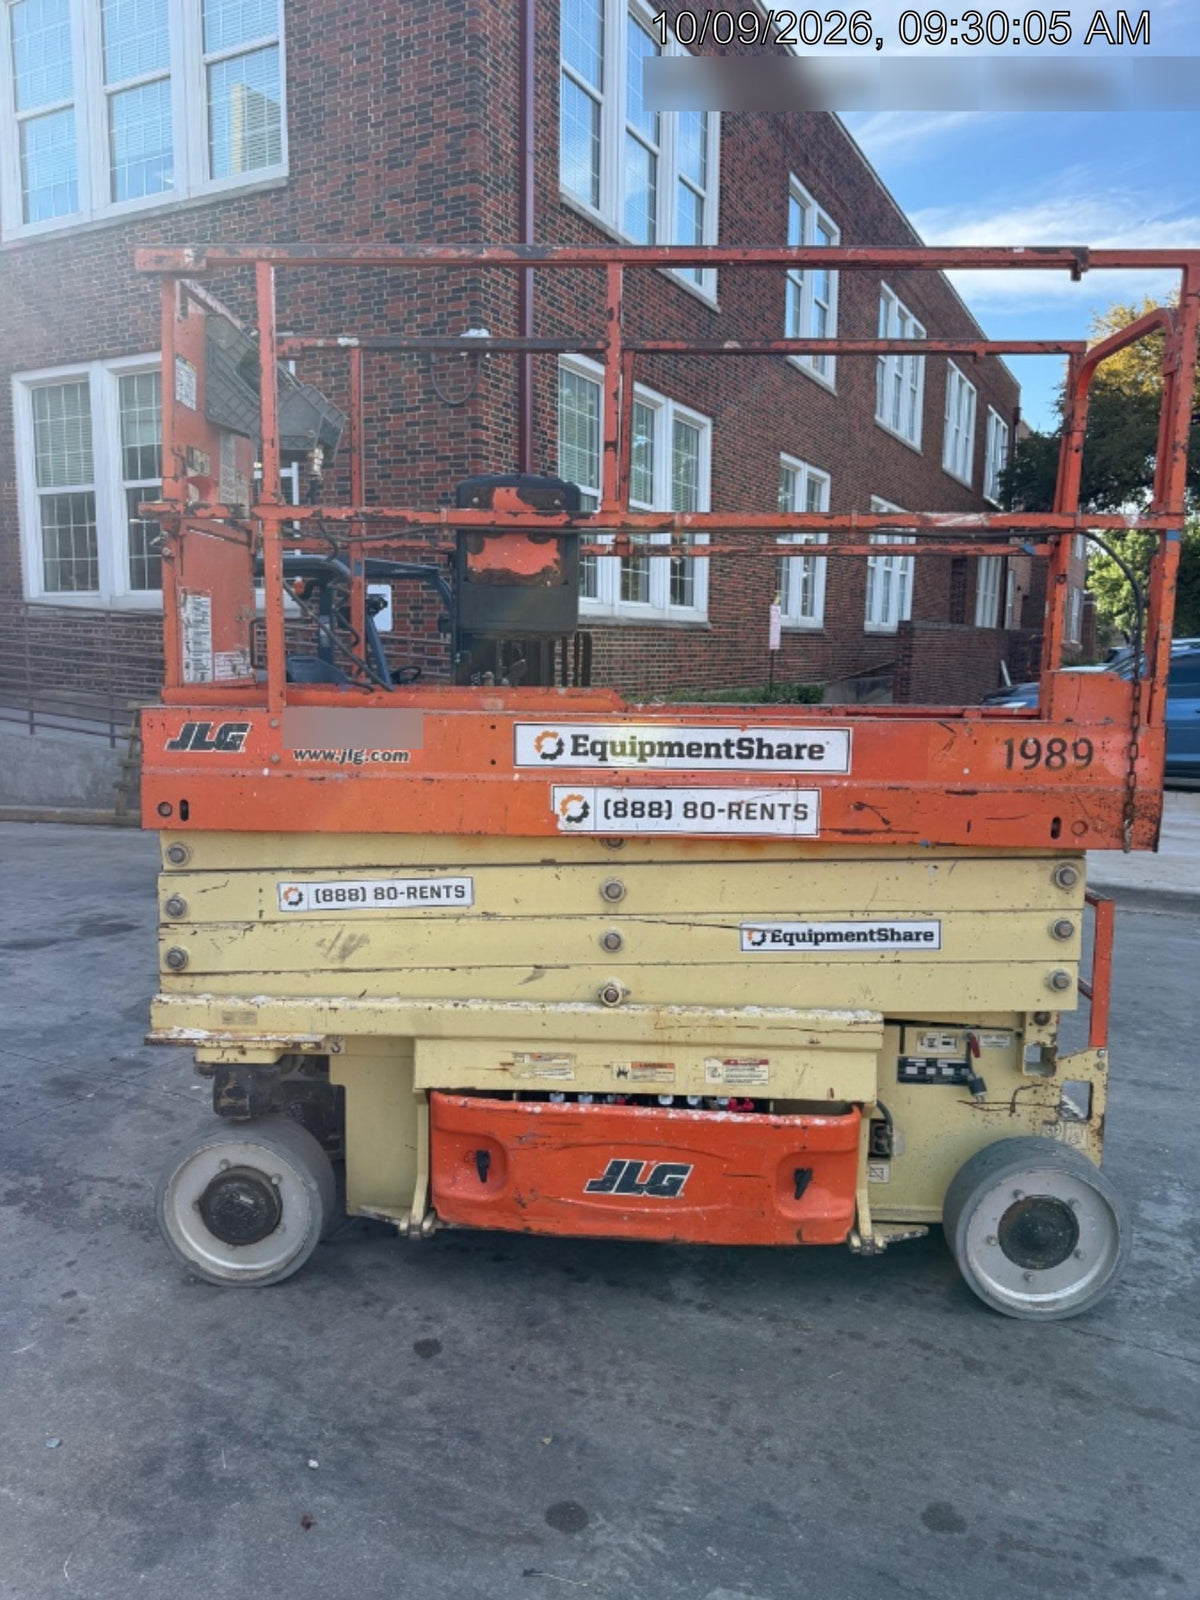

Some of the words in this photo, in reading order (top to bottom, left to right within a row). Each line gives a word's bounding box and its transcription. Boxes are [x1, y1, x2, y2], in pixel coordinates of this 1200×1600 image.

[164, 721, 251, 752] JLG
[570, 733, 826, 762] EquipmentShare
[293, 749, 409, 765] www.jlg.com
[1004, 737, 1094, 771] 1989
[603, 799, 673, 821] (888)
[682, 800, 809, 821] 80-RENTS
[314, 886, 367, 904] (888)
[373, 884, 466, 901] 80-RENTS
[770, 927, 935, 946] EquipmentShare
[582, 1158, 694, 1198] JLG
